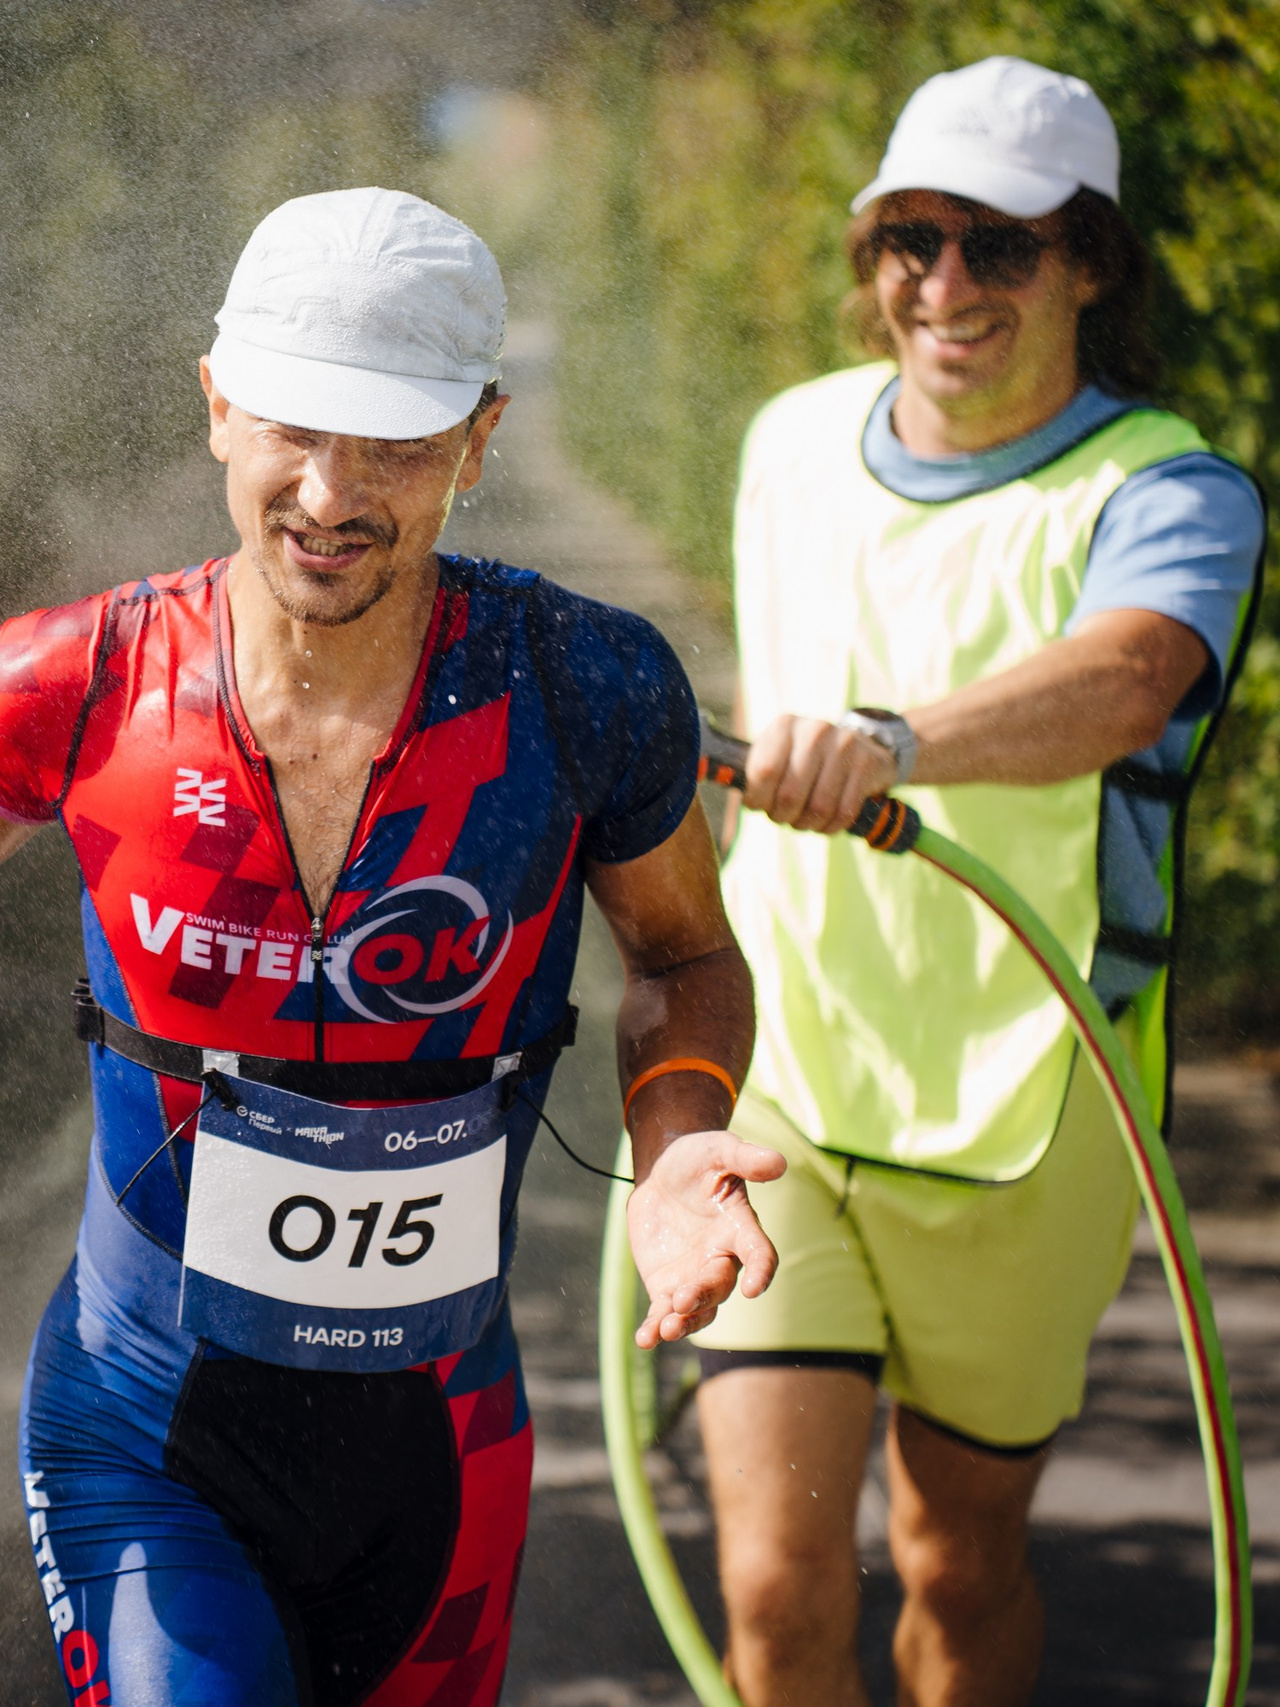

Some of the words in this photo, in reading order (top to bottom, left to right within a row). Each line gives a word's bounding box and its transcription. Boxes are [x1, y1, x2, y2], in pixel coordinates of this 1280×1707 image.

[185, 912, 225, 931] SWIM
[229, 923, 262, 938] BIKE
[266, 929, 299, 942] RUN
[293, 1324, 366, 1348] HARD
[371, 1327, 404, 1347] 113
